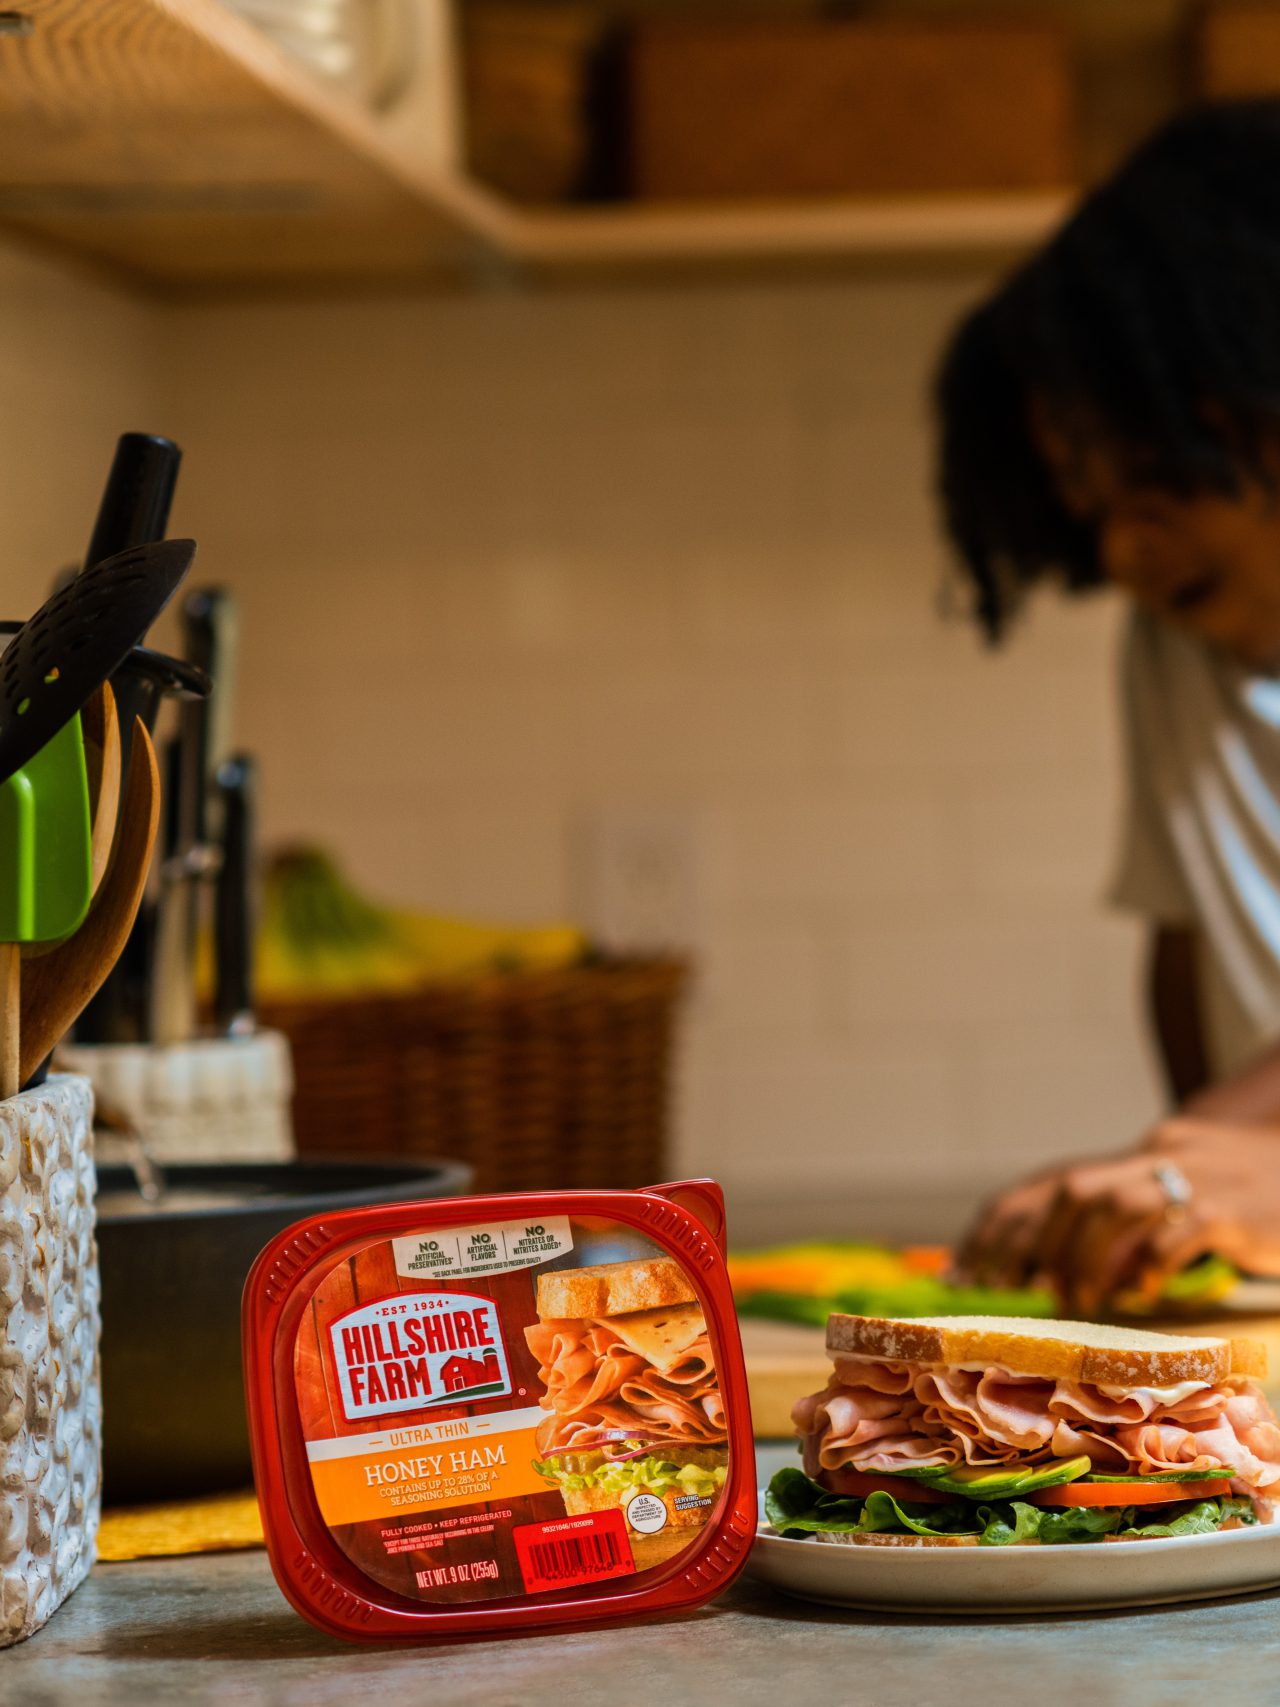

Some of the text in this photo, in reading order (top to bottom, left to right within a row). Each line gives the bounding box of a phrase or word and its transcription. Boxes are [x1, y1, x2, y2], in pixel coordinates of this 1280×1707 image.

[525, 1225, 545, 1237] NO
[471, 1233, 491, 1245] NO
[518, 1236, 546, 1246] NITRATES
[419, 1240, 439, 1253] NO
[467, 1244, 498, 1254] ARTIFICIAL
[513, 1244, 539, 1255] NITRITES
[415, 1252, 445, 1262] ARTIFICIAL
[471, 1251, 496, 1261] FLAVORS
[382, 1300, 443, 1316] EST 1934
[341, 1307, 495, 1366] HILLSHIRE
[348, 1357, 432, 1406] FARM
[389, 1422, 469, 1446] ULTRA THIN
[364, 1445, 507, 1486] HONEY HAM
[380, 1471, 499, 1498] CONTAINS UP TO 28% OF A
[391, 1482, 491, 1506] SEASONING SOLUTION
[674, 1494, 699, 1504] SERVING
[639, 1497, 651, 1505] U.S.
[675, 1498, 711, 1510] SUGGESTION
[381, 1509, 512, 1537] FULLY COOKED KEEP REFRIGERATED
[416, 1560, 499, 1588] NET WT. 9 OZ (255g)
